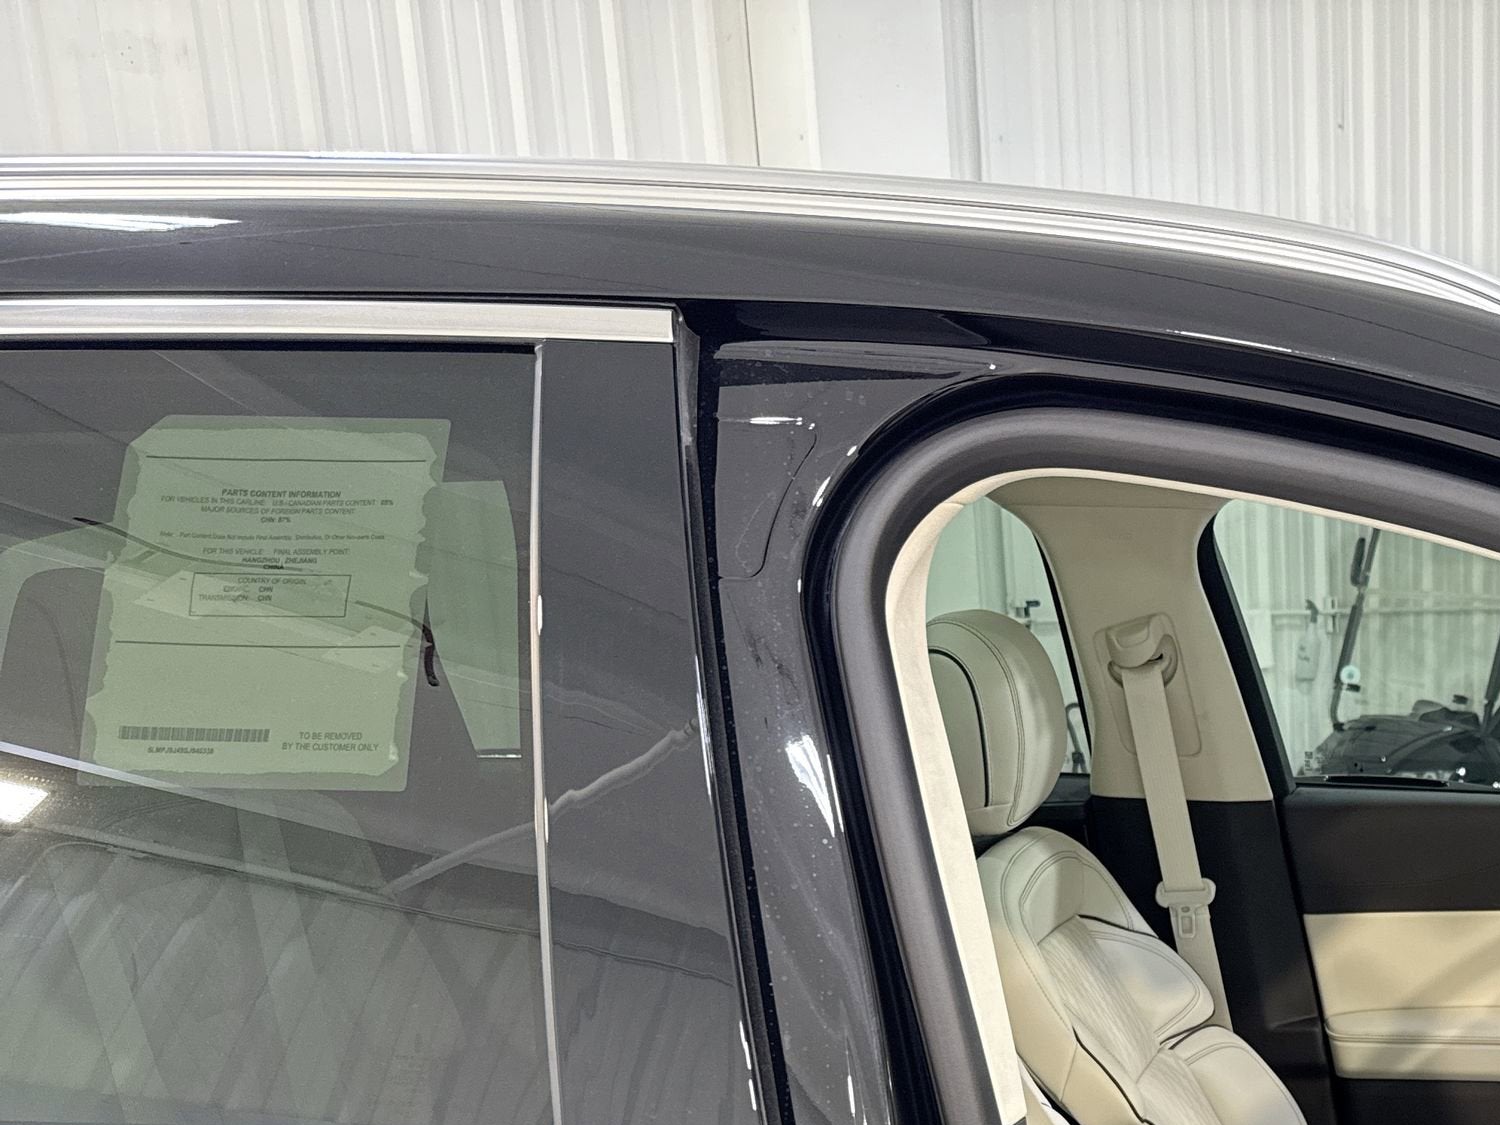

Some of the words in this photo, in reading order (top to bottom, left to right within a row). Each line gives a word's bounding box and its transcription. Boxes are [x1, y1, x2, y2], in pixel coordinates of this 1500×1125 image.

[222, 489, 248, 497] PARTS
[250, 490, 287, 498] CONTENT
[288, 490, 341, 498] INFORMATION
[177, 496, 209, 504] VEHICLES
[201, 505, 225, 513] MAJOR
[302, 507, 322, 515] PARTS
[299, 731, 311, 740] TO
[311, 732, 322, 740] BE
[324, 731, 363, 741] REMOVED
[281, 742, 293, 750] BY
[295, 742, 311, 751] THE
[312, 742, 356, 752] CUSTOMER
[357, 743, 380, 752] ONLY
